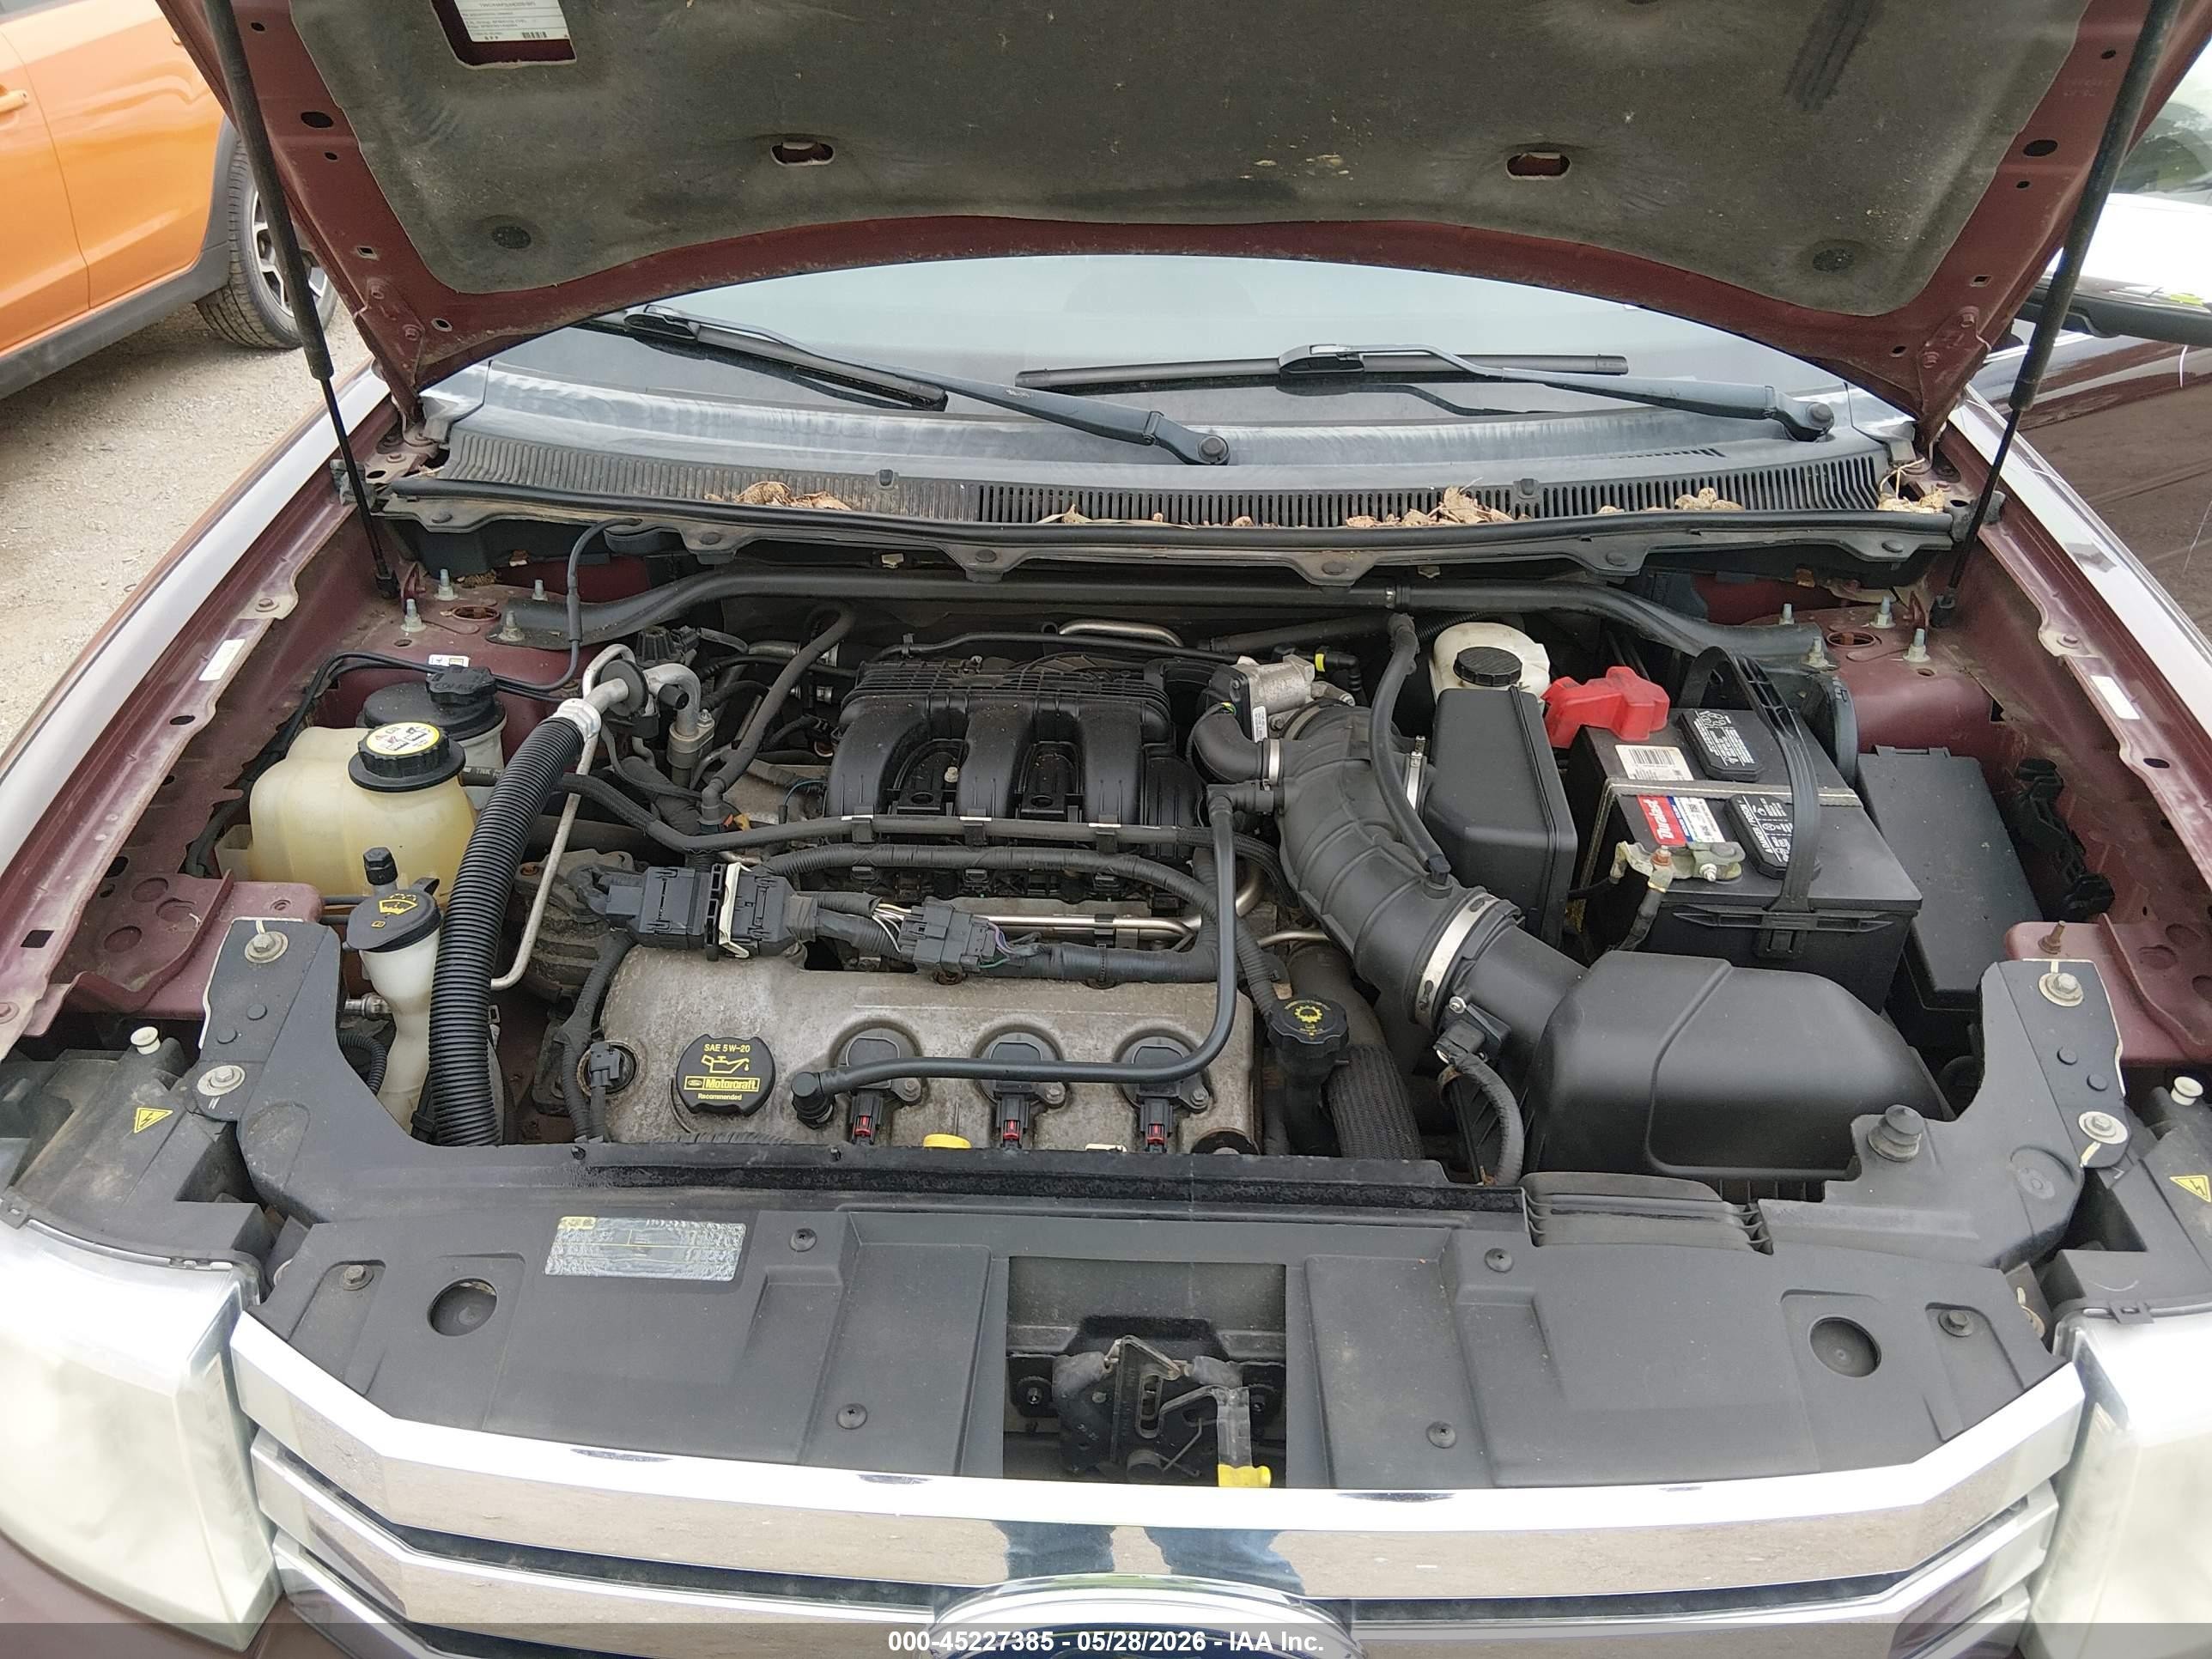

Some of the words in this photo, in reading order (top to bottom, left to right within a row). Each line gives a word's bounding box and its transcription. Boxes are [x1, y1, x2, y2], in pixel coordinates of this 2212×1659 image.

[1643, 799, 1674, 839] Duralast
[1739, 804, 1756, 823] POISON
[1752, 827, 1770, 848] DANGER
[723, 1044, 750, 1053] 5W-20
[705, 1078, 757, 1090] Motorcraft
